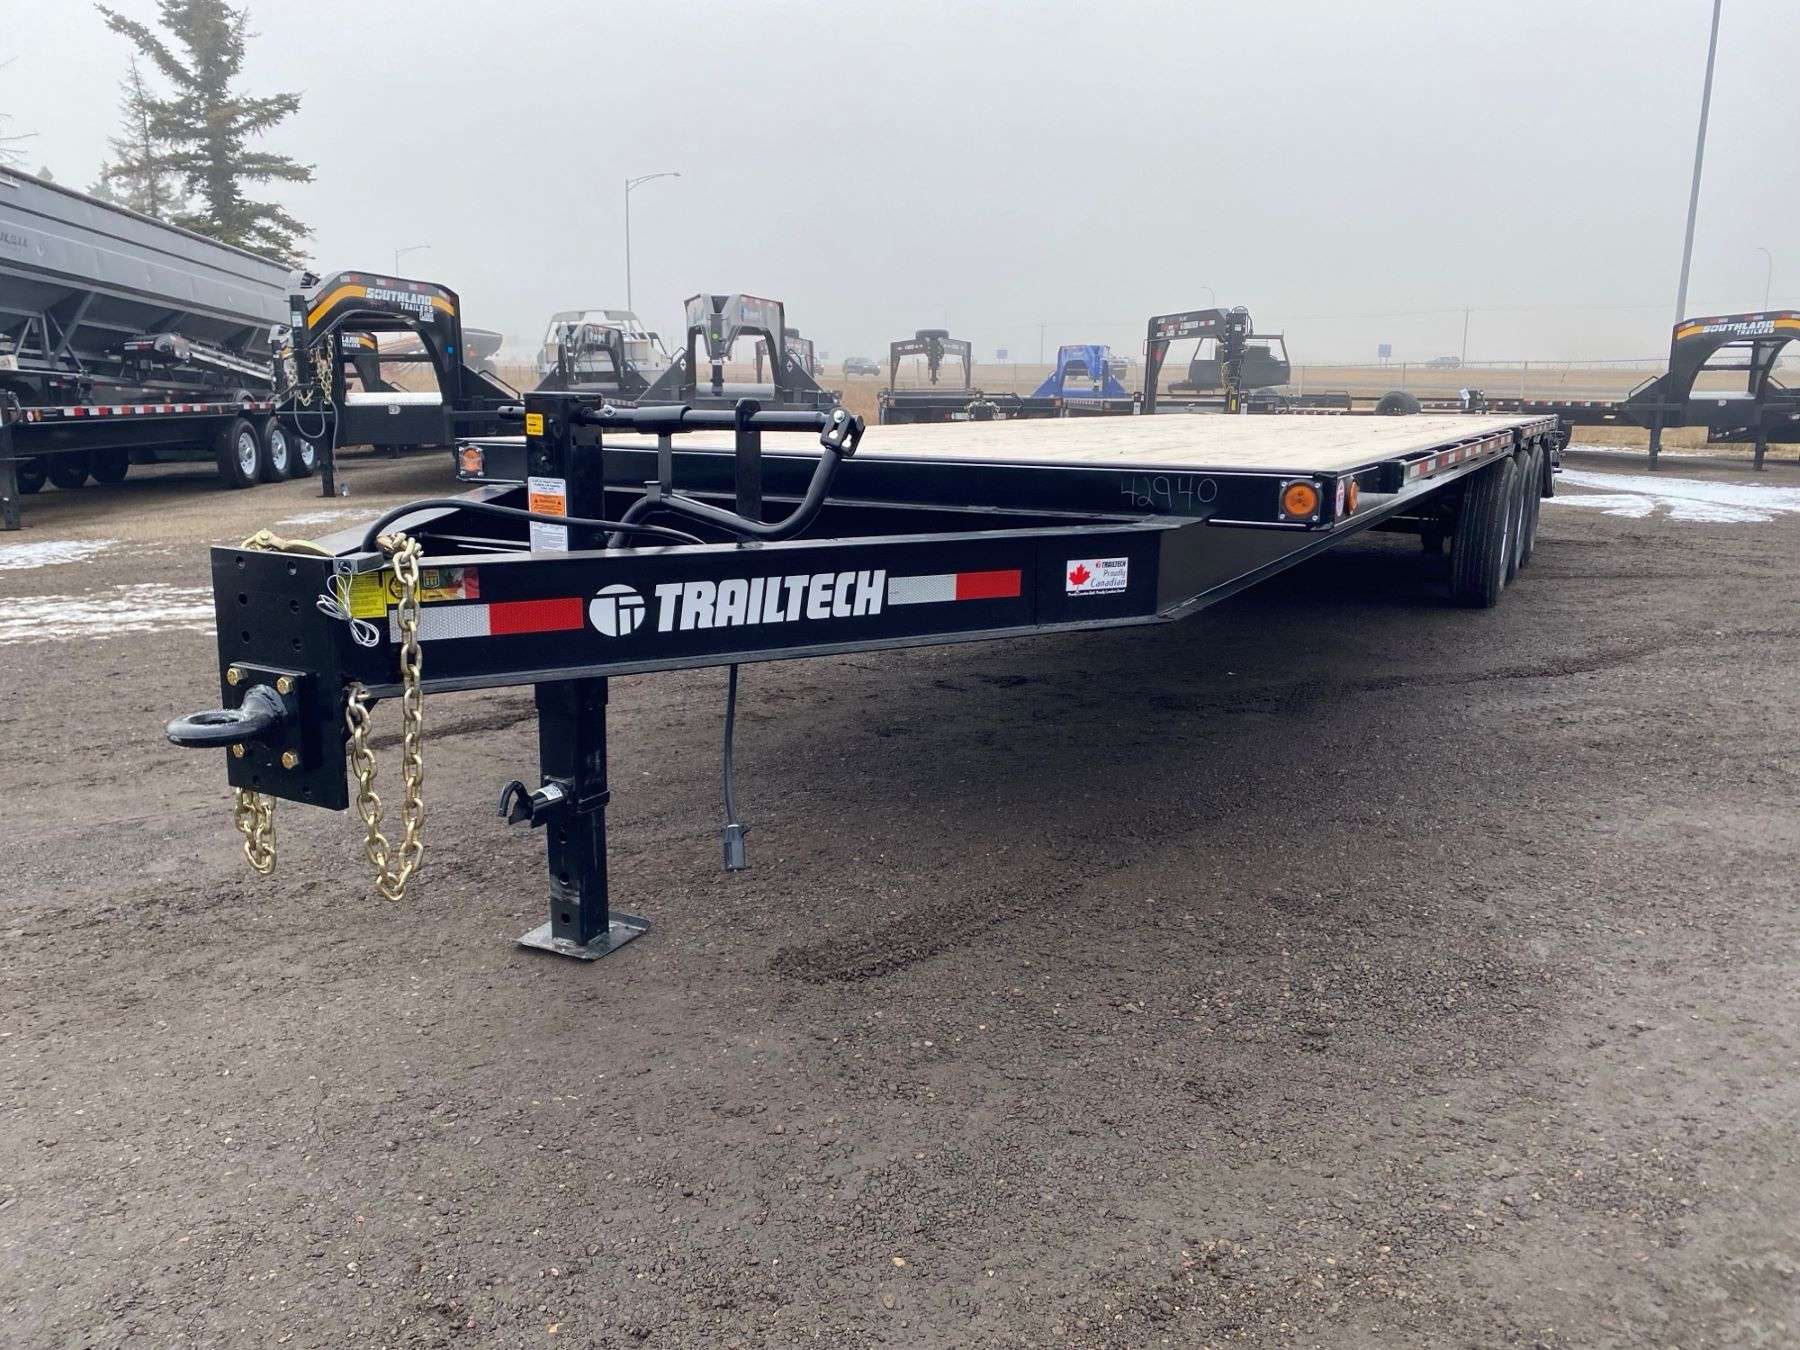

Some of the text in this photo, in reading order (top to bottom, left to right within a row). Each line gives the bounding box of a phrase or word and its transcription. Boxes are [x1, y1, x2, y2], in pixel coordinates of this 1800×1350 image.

[366, 287, 432, 305] SOUTHLAND
[400, 302, 433, 313] TRAILERS
[1702, 320, 1775, 334] SOUTHLAND
[1736, 328, 1775, 336] TRAILERS
[1120, 475, 1218, 511] 42940
[1090, 577, 1126, 588] Canadian
[655, 569, 886, 632] TRAILTECH
